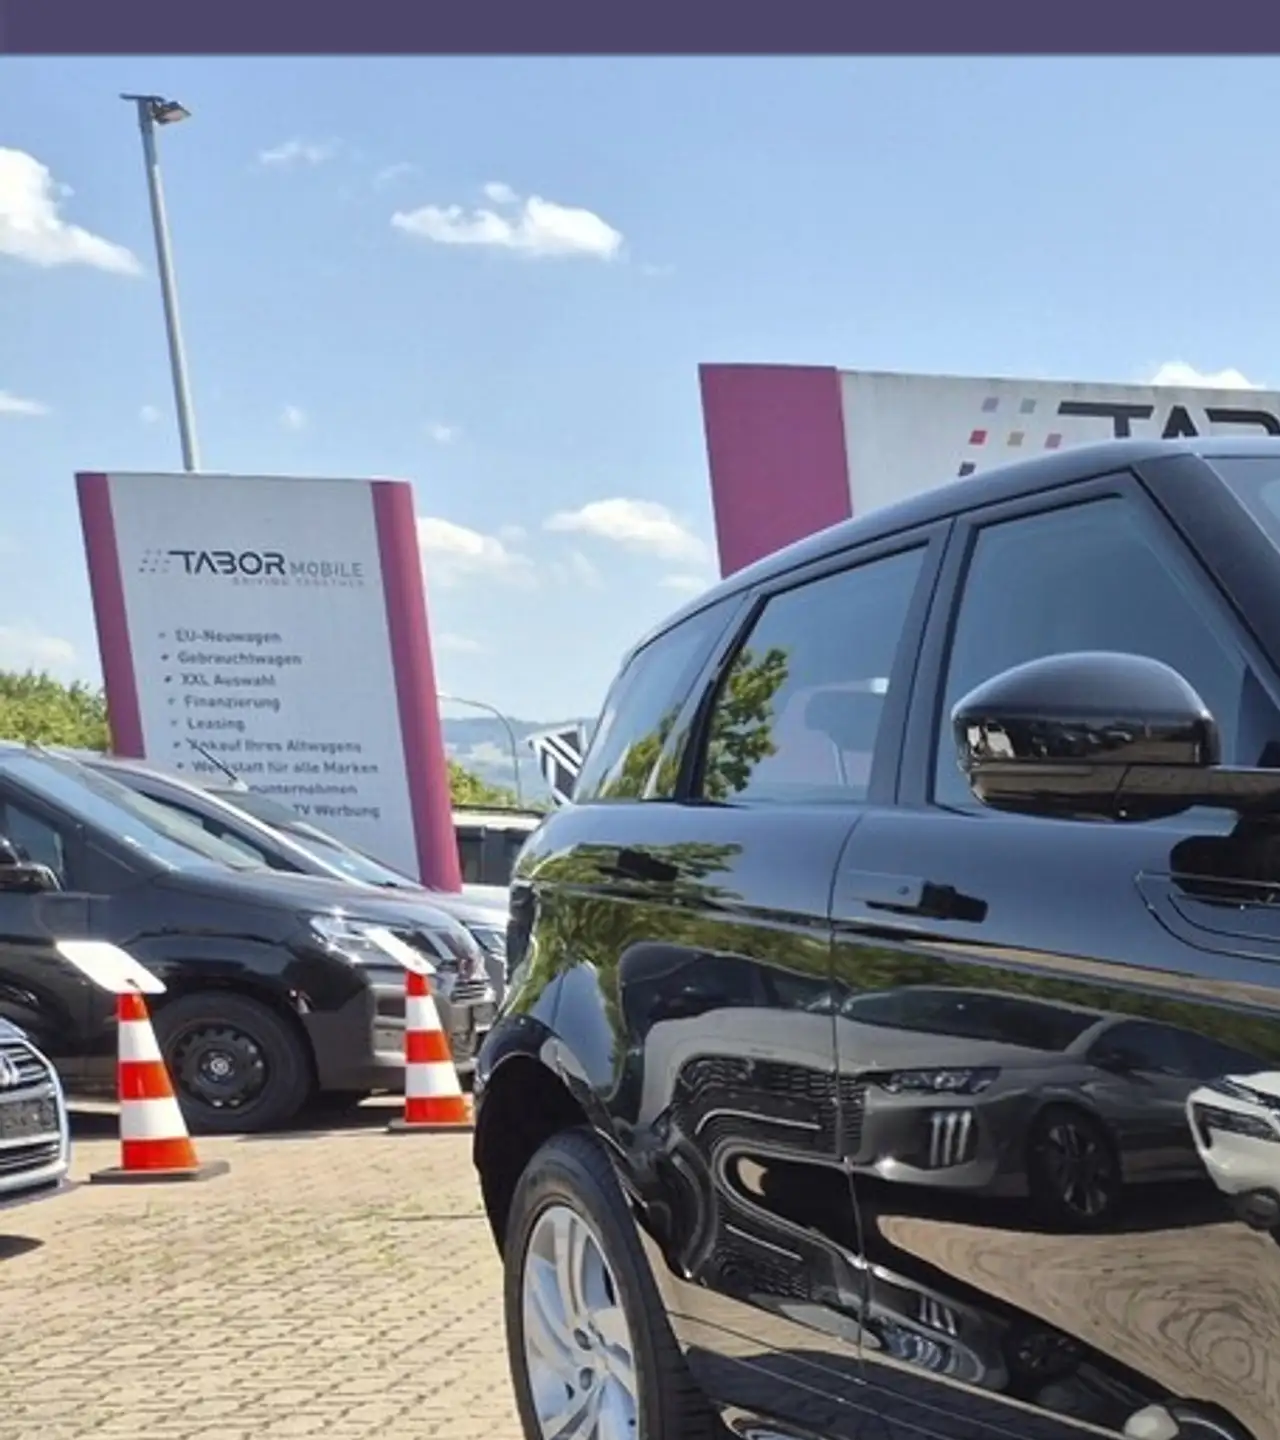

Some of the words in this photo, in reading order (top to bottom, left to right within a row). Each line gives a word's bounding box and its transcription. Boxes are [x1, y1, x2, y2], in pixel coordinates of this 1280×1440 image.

[167, 550, 286, 576] TABOR
[289, 561, 364, 578] MOBILE
[174, 629, 282, 645] EU-Neuwagen
[177, 652, 302, 667] Gebrauchtwagen
[180, 674, 209, 687] XXL
[213, 674, 276, 687] Auswahl
[184, 695, 281, 712] Finanzierung
[187, 717, 246, 732] Leasing
[245, 740, 283, 752] Ihres
[287, 740, 362, 754] Altwagens
[268, 760, 289, 774] für
[293, 760, 320, 774] alle
[323, 760, 379, 774] Marken
[313, 804, 381, 819] Werbung
